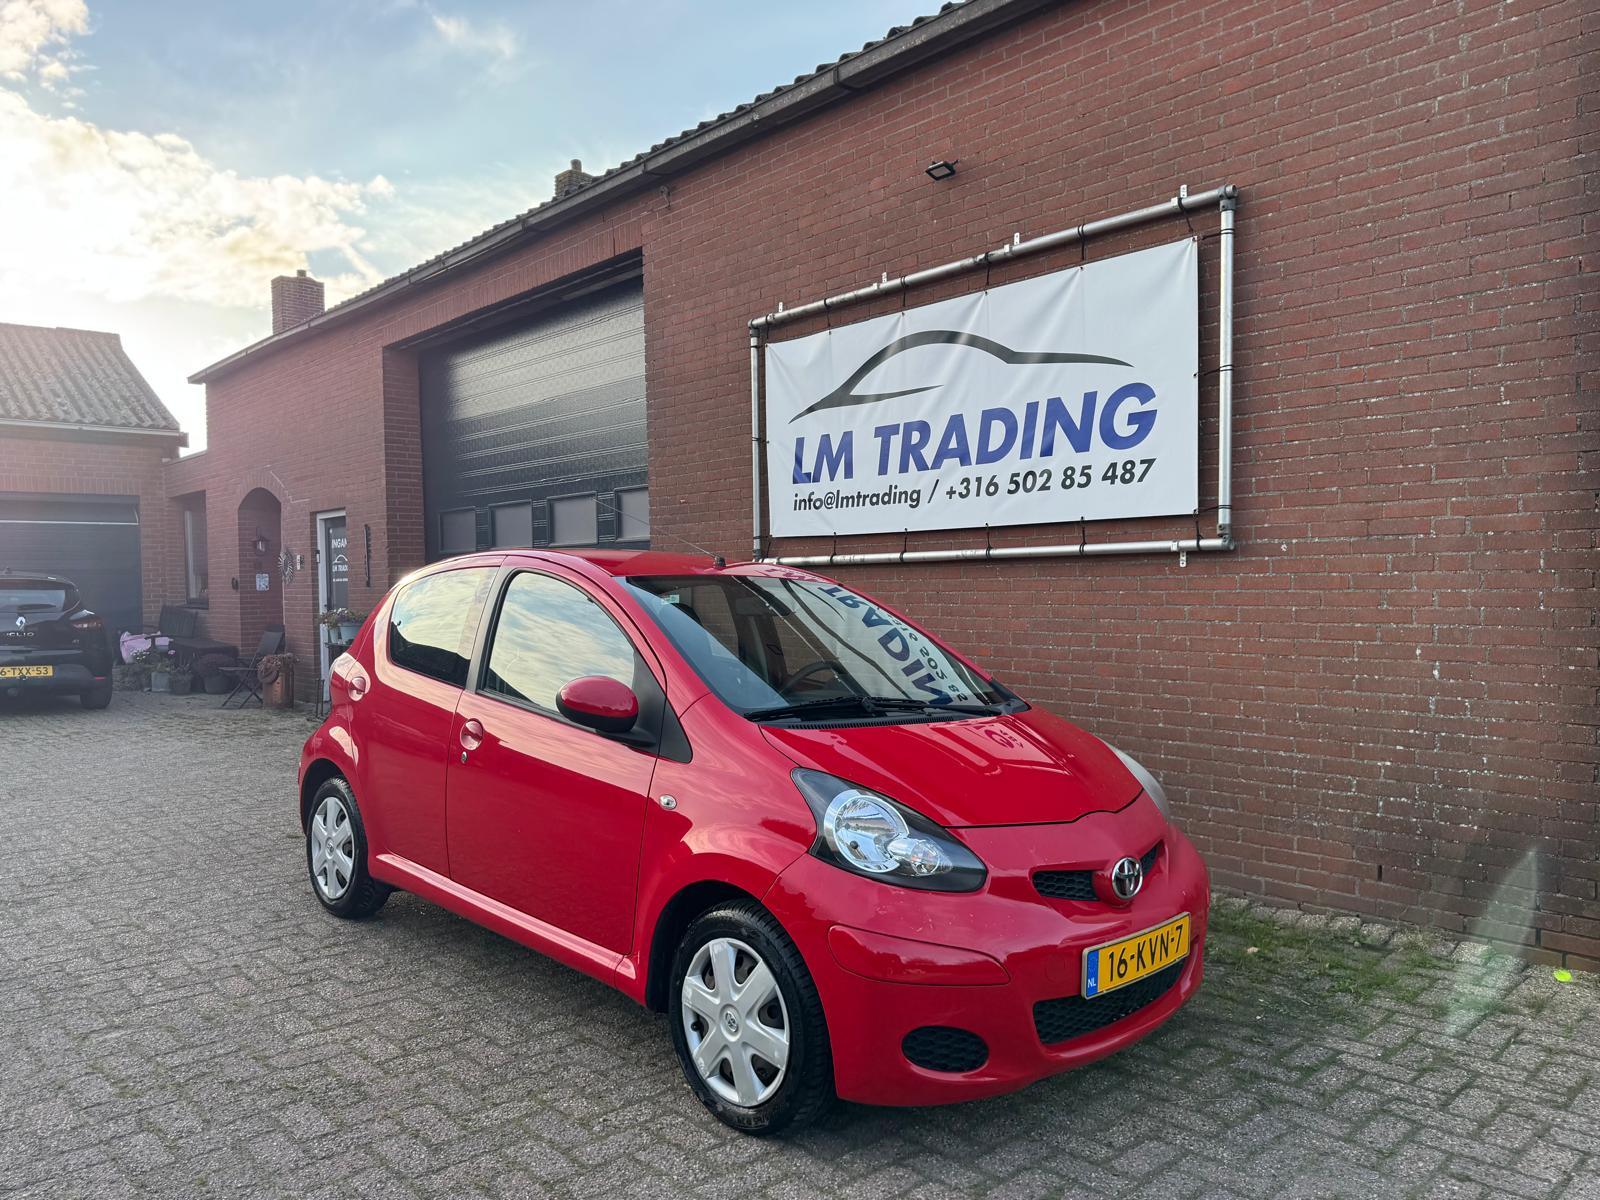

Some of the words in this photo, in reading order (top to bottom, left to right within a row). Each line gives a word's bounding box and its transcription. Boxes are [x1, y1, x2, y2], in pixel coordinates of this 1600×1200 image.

[792, 430, 854, 485] LM
[873, 382, 1158, 476] TRADING
[793, 484, 921, 512] info@lmtrading
[927, 478, 940, 504] /
[945, 474, 1000, 501] +316
[1007, 468, 1053, 495] 502
[1060, 464, 1093, 490] 85
[1101, 457, 1158, 486] 487
[1109, 924, 1183, 982] 16-KVN-7
[1087, 978, 1097, 988] NL
